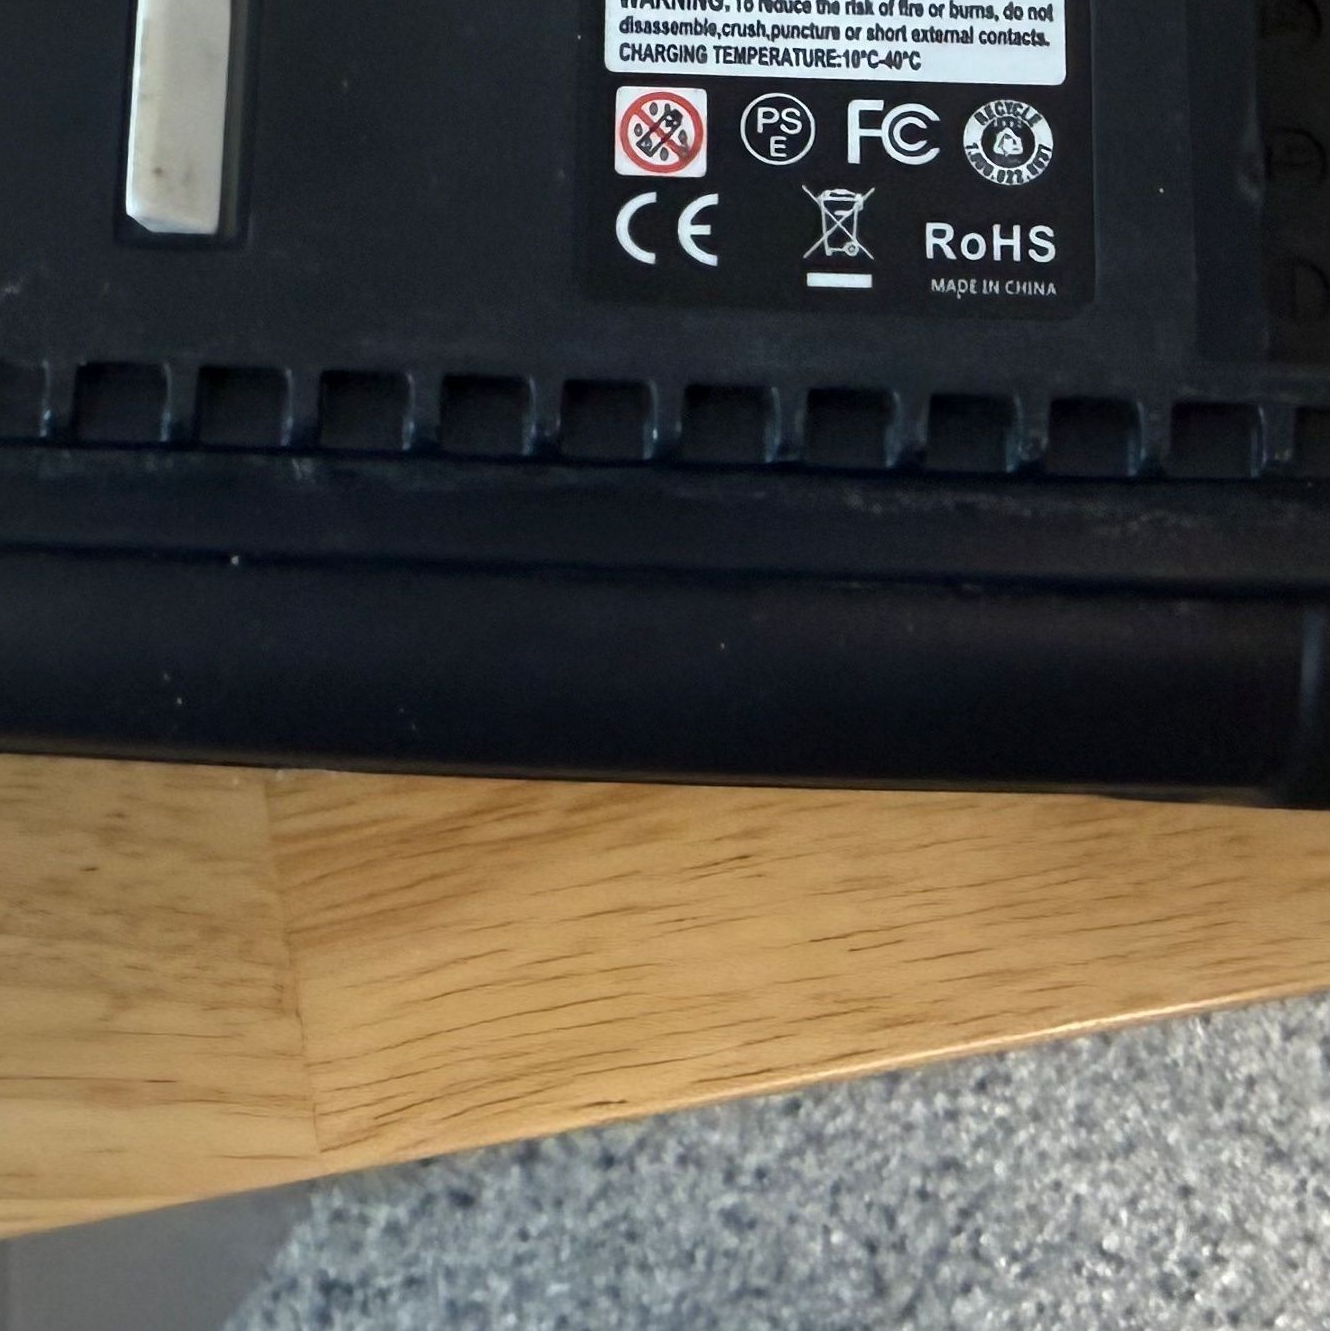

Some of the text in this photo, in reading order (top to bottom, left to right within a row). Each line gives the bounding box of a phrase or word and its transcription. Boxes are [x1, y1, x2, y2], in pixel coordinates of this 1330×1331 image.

[928, 3, 945, 18] or
[949, 0, 1000, 21] burns,
[1003, 1, 1024, 21] do
[1028, 3, 1054, 22] not
[845, 26, 862, 40] or
[867, 23, 907, 42] short
[911, 26, 974, 44] external
[979, 29, 1051, 47] contacts.
[619, 42, 708, 64] CHARGING
[925, 222, 1056, 263] RoHS
[931, 277, 1057, 299] MADE IN CHINA
